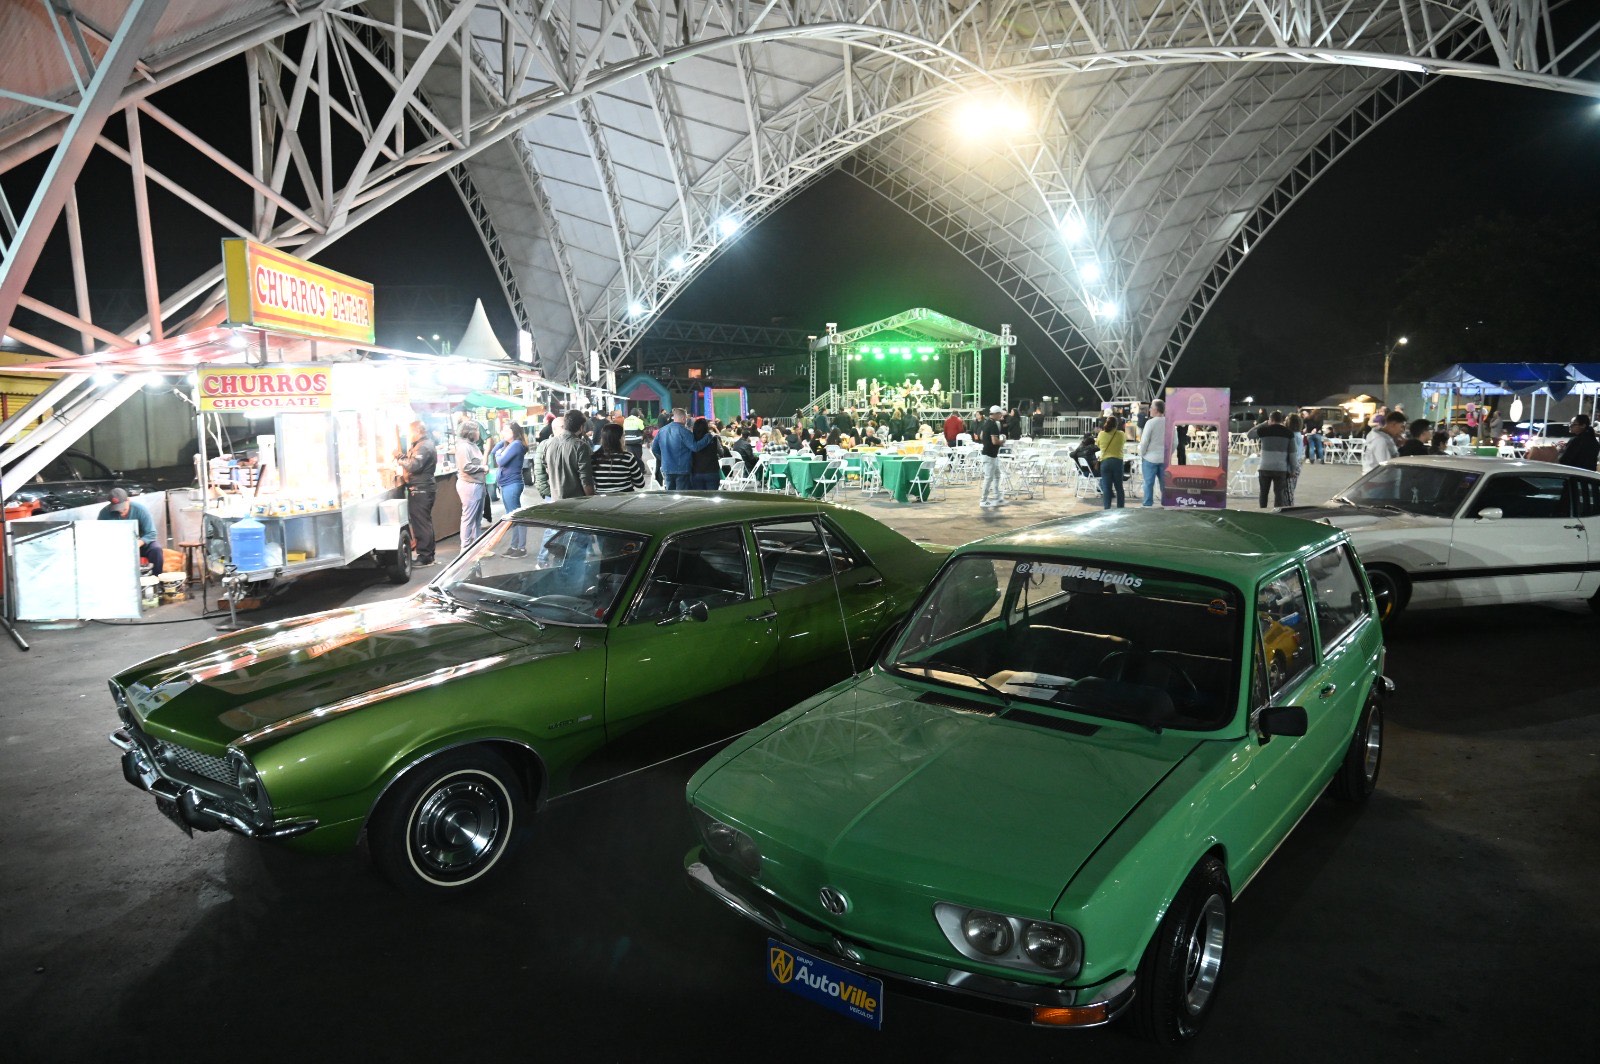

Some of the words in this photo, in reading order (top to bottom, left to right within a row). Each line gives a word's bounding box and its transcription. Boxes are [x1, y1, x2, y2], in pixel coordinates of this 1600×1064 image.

[256, 266, 326, 317] CHURROS
[332, 291, 370, 326] BATATA
[203, 373, 327, 394] CHURROS
[212, 397, 319, 408] CHOCOLATE
[797, 955, 814, 967] GRUPO
[795, 966, 877, 1012] AutoVille
